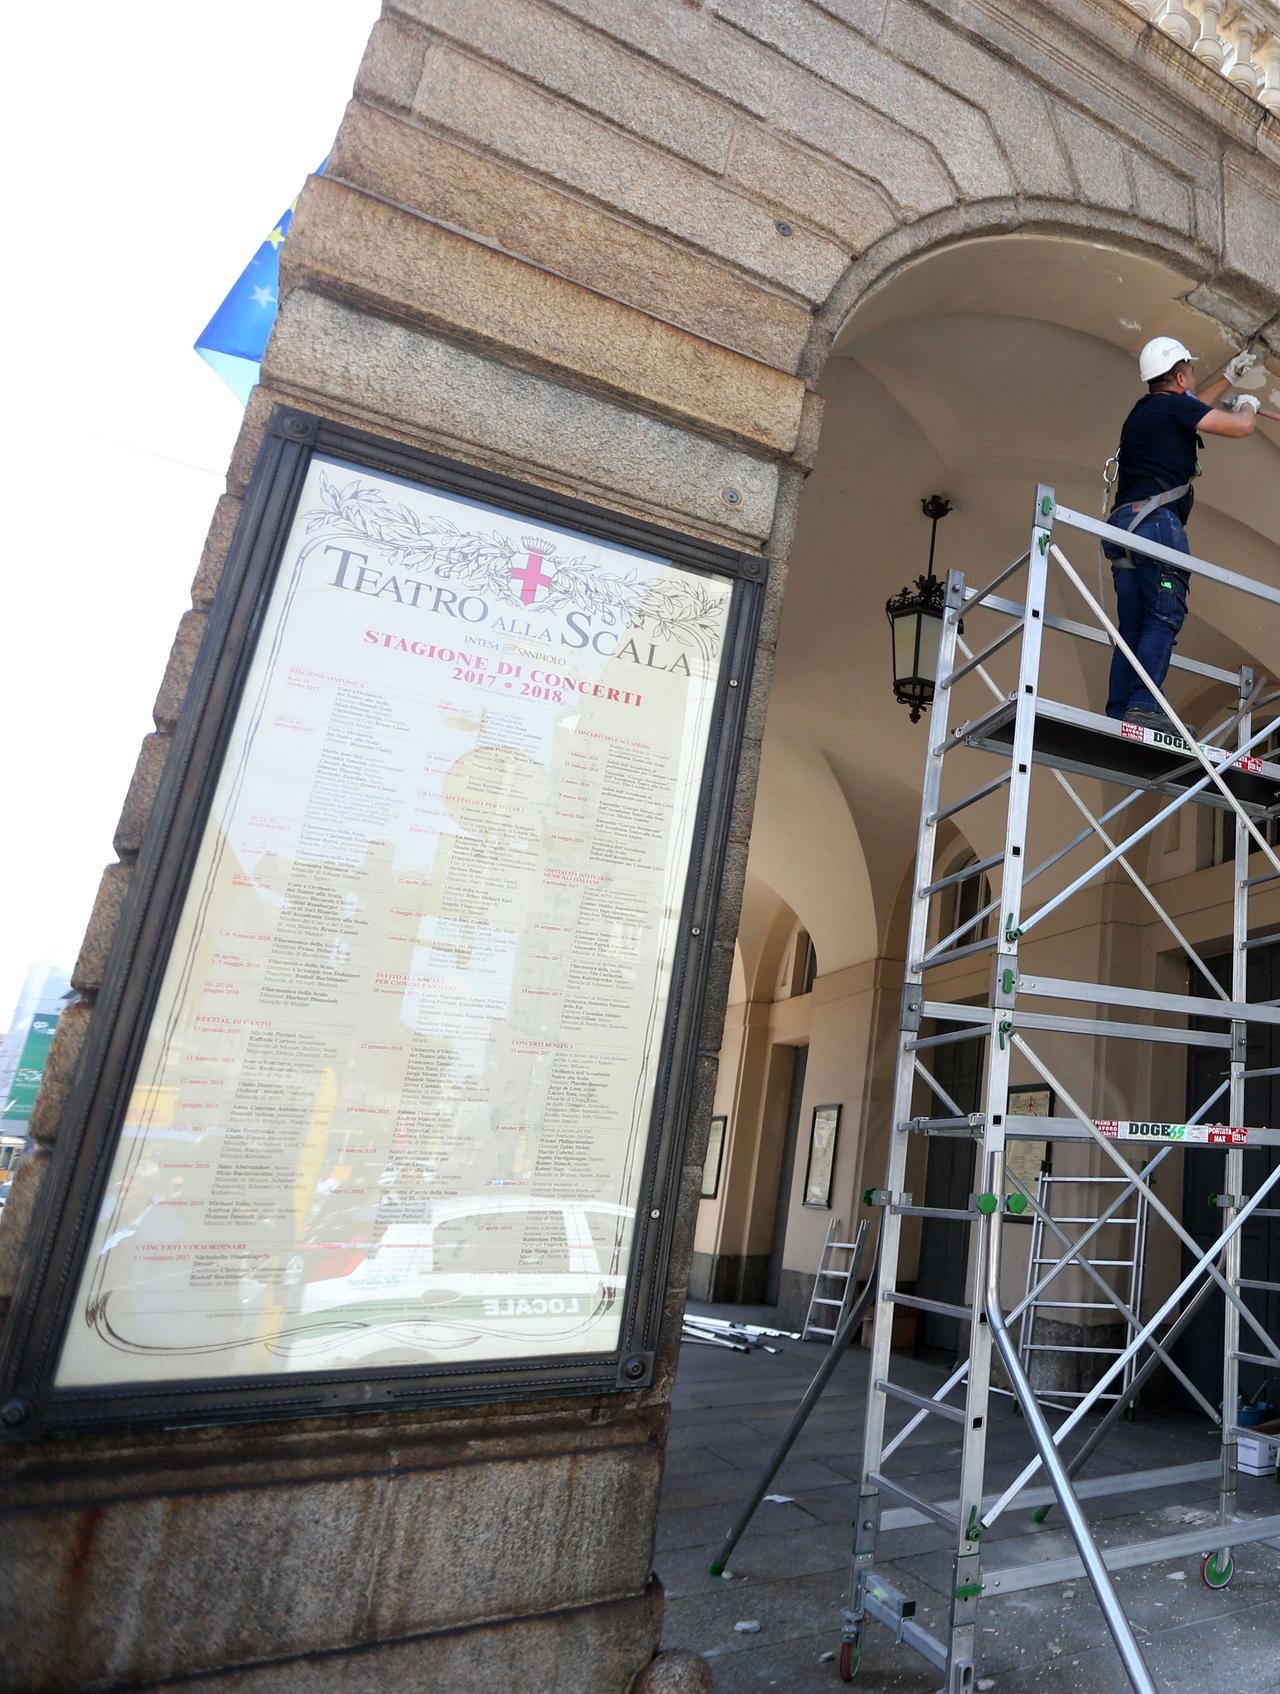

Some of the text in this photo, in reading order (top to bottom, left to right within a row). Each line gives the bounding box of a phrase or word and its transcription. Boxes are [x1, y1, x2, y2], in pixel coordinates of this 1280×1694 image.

[323, 543, 692, 677] TEATRO ALLA SCALA
[464, 634, 567, 666] INTESA SANPAOLO
[363, 629, 643, 708] STAGIONE DI CONCERTI
[450, 666, 563, 703] 2017 2018
[1128, 1122, 1170, 1137] DOGE
[1214, 1135, 1228, 1143] MAX
